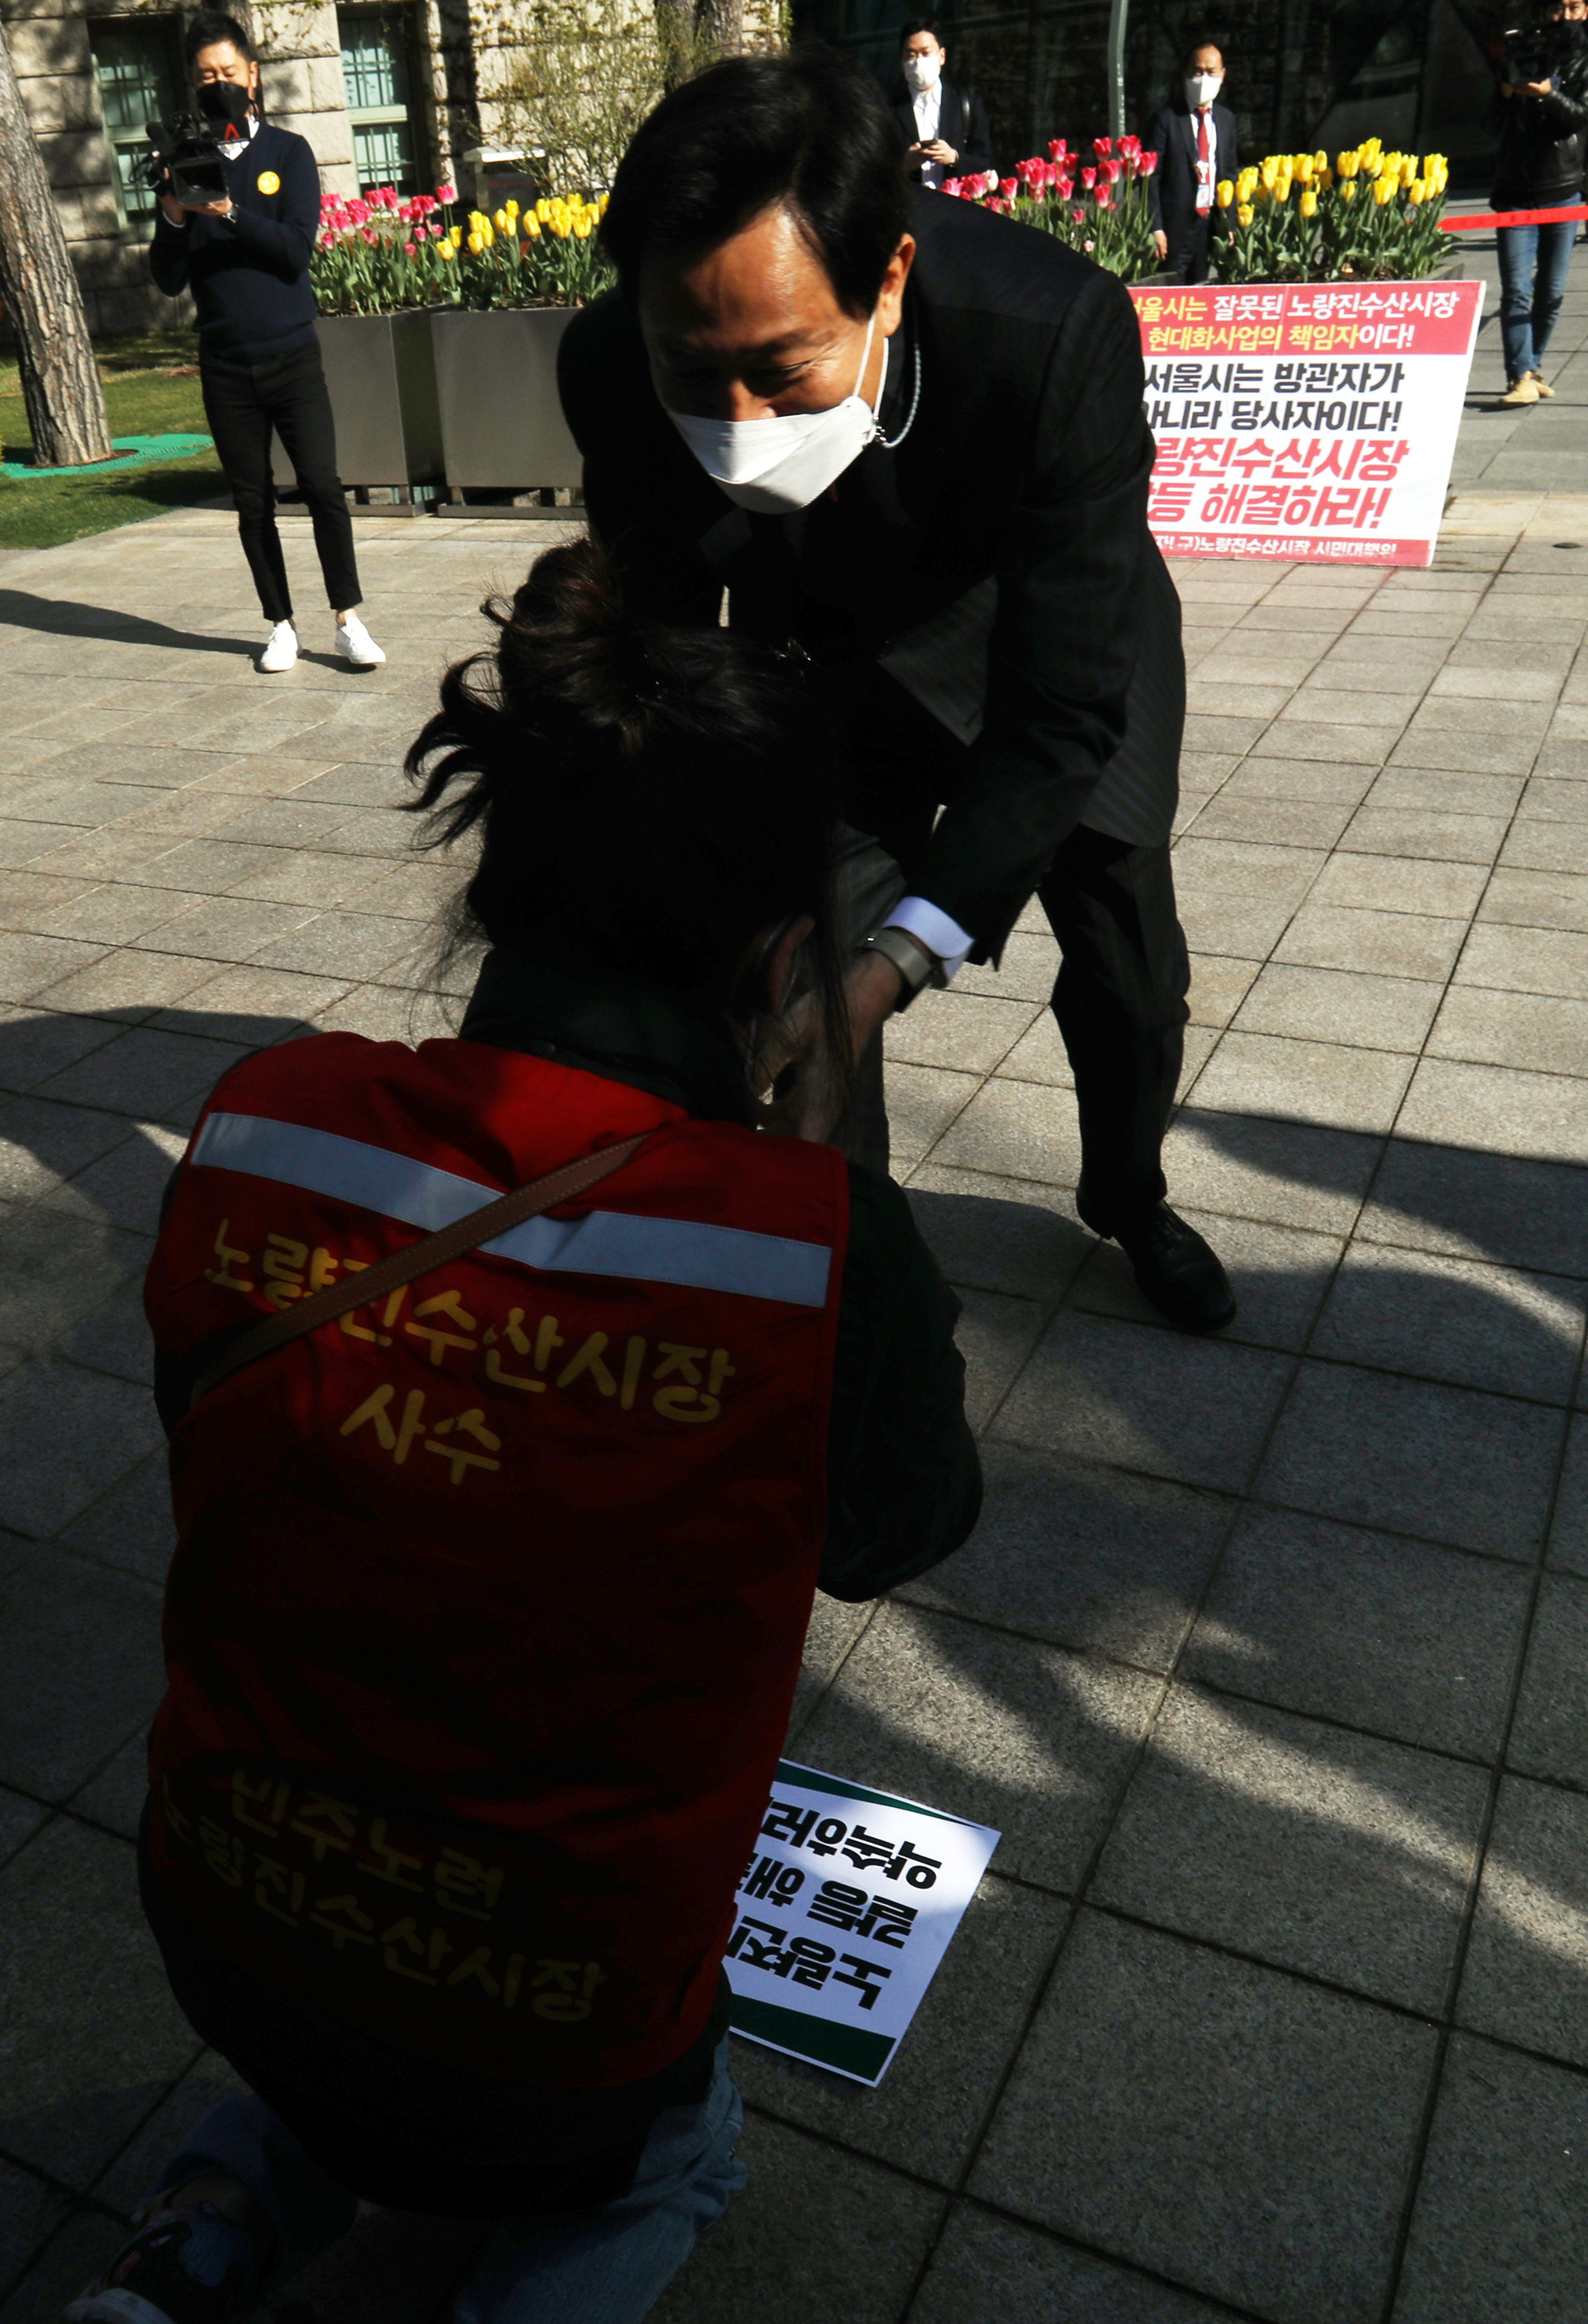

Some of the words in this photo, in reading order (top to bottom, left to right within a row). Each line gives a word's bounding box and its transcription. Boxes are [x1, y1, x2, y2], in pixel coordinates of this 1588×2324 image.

[1213, 294, 1283, 322] 잘못된
[1287, 291, 1459, 320] 노량진수산시장
[1148, 326, 1282, 352] 현대화사업의
[1289, 323, 1415, 350] 책임자이다!
[1144, 363, 1264, 393] 서울시는
[1273, 363, 1405, 393] 방관자가
[1231, 400, 1403, 431] 당사자이다!
[1147, 482, 1196, 522] 등
[1201, 483, 1392, 529] 해결하라!
[340, 1384, 501, 1485] 사수
[735, 1852, 806, 1907] 해
[807, 1879, 919, 1949] 갈등
